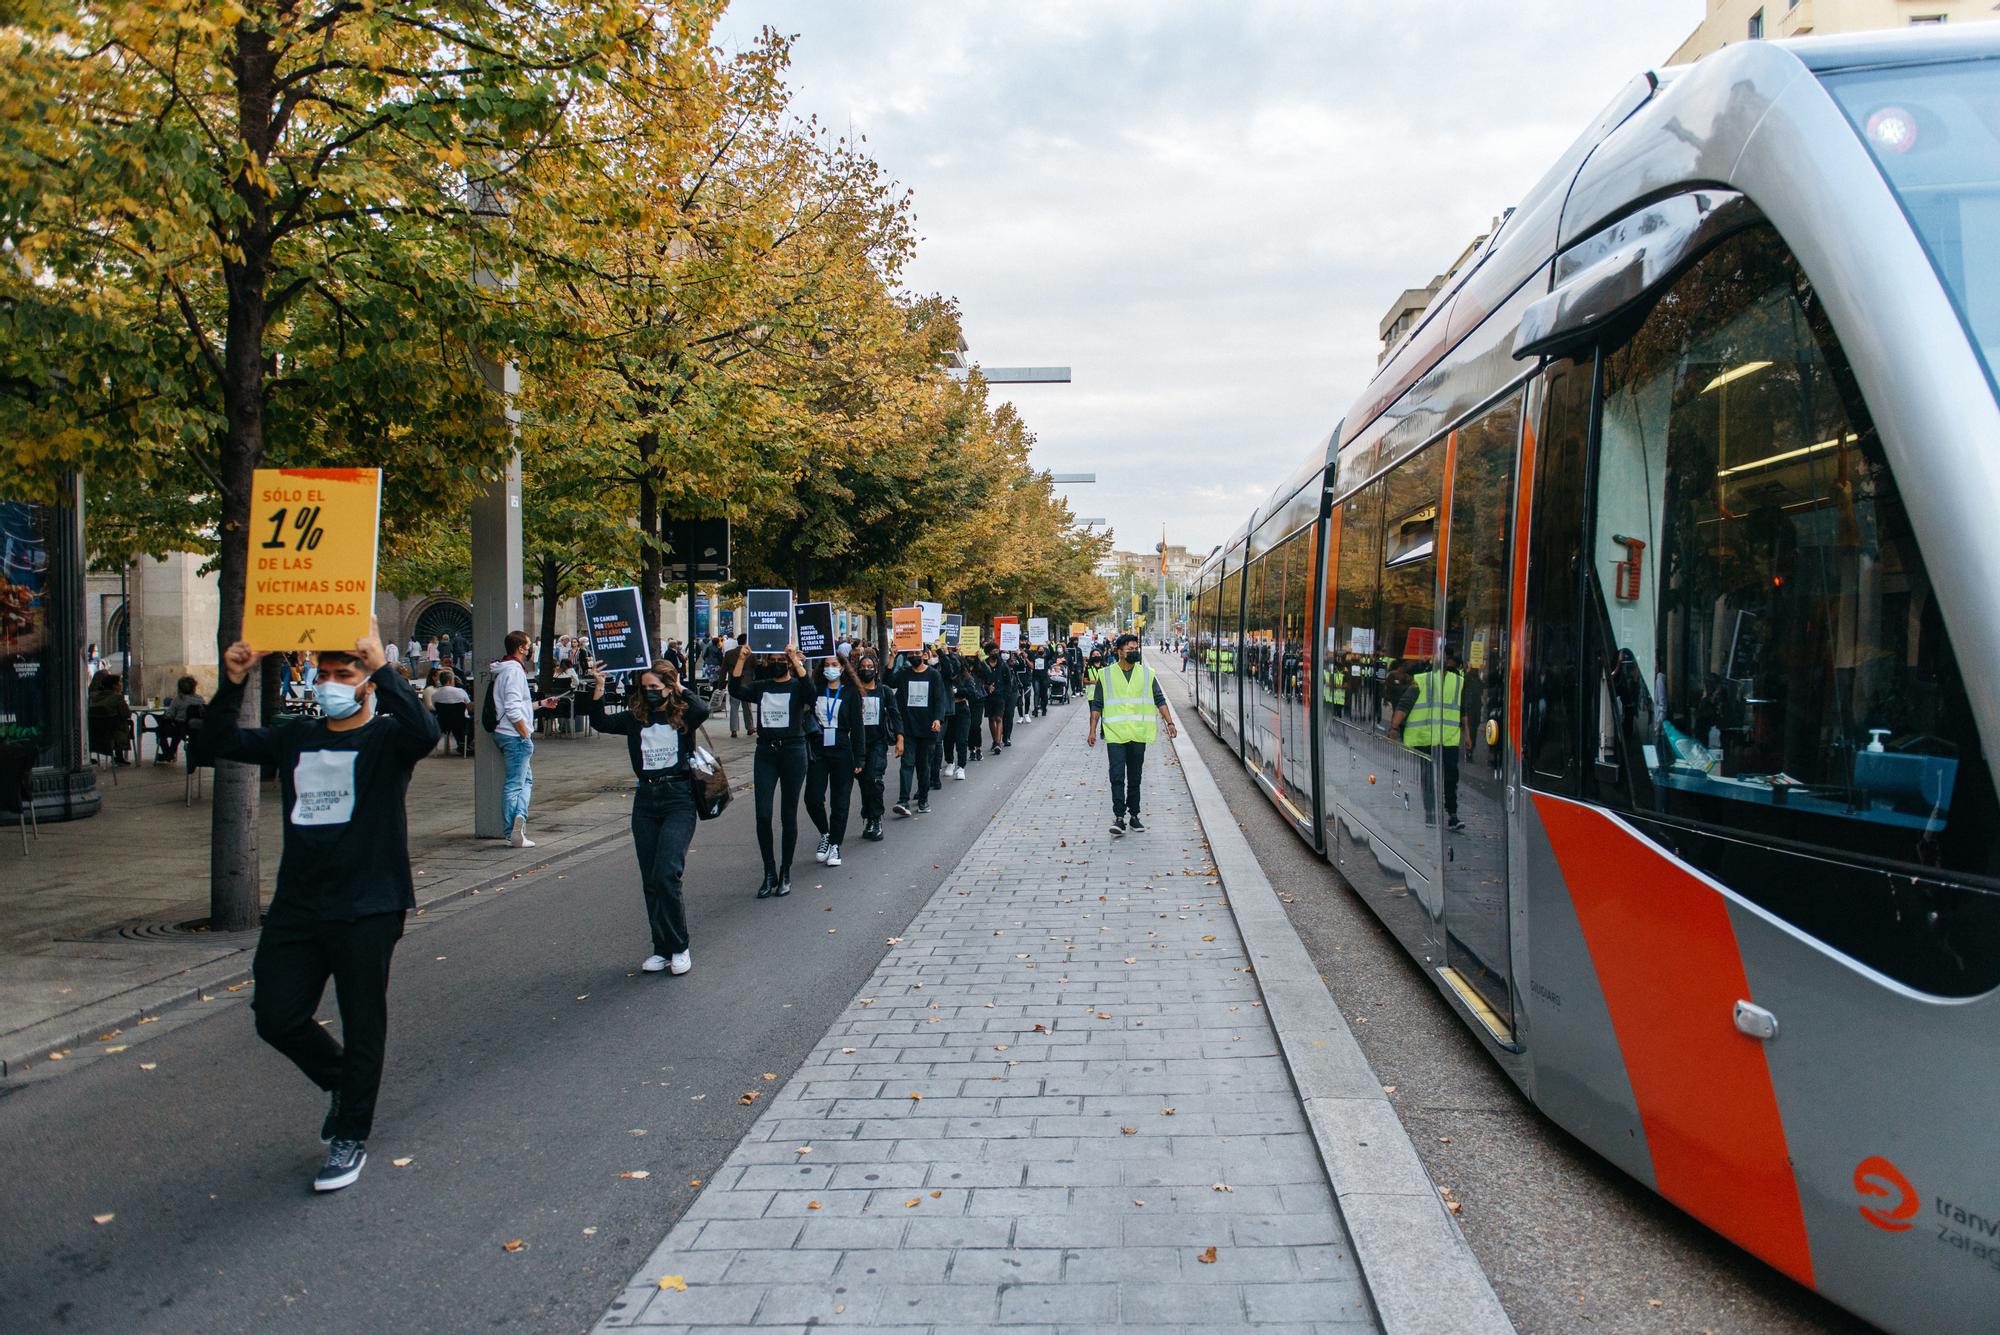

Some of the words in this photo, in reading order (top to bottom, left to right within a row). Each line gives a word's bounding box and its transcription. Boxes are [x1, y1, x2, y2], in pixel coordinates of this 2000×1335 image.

[263, 487, 302, 502] SÓLO
[307, 490, 326, 502] EL
[261, 505, 324, 551] 1%
[258, 558, 278, 570] DE
[283, 558, 313, 570] LAS
[257, 577, 329, 593] VÍCTIMAS
[335, 580, 366, 592] SON
[255, 603, 360, 616] RESCATADAS.
[1936, 1196, 2000, 1241] tranv
